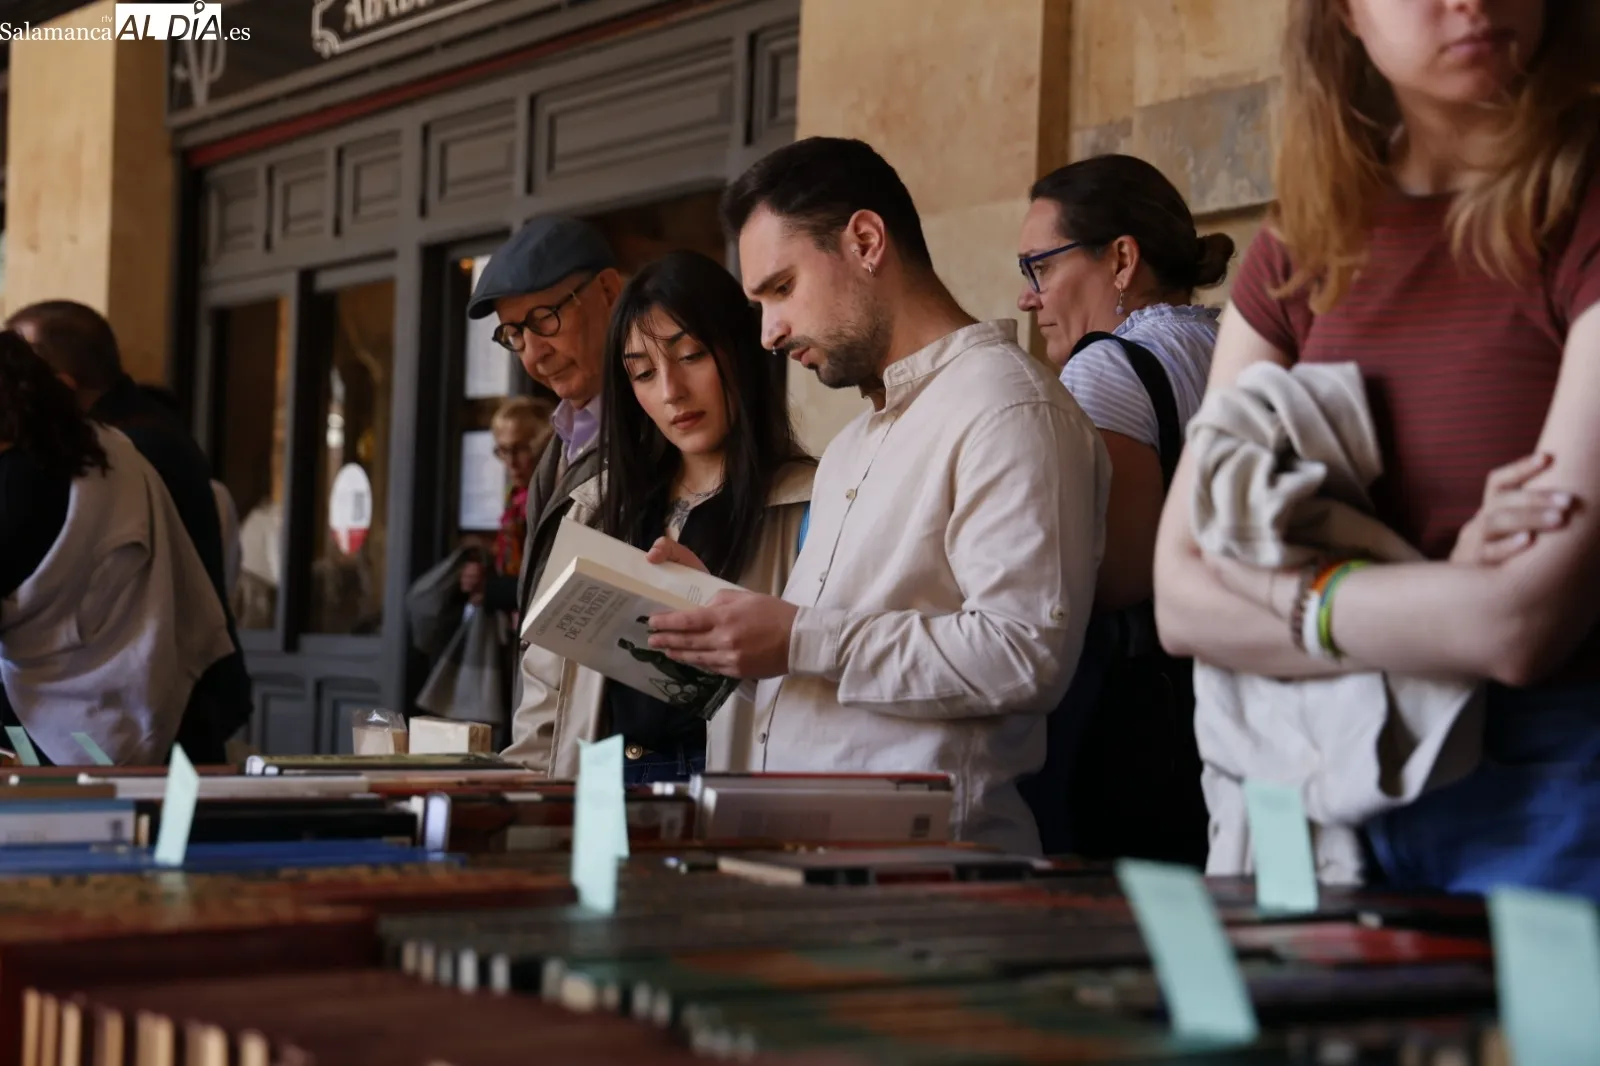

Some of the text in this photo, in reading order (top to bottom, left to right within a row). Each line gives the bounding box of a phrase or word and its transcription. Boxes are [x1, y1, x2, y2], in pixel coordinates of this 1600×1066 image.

[556, 586, 600, 631] POR EL BIEN
[583, 590, 614, 616] PATRIA
[575, 616, 592, 627] LA
[564, 626, 582, 640] DE
